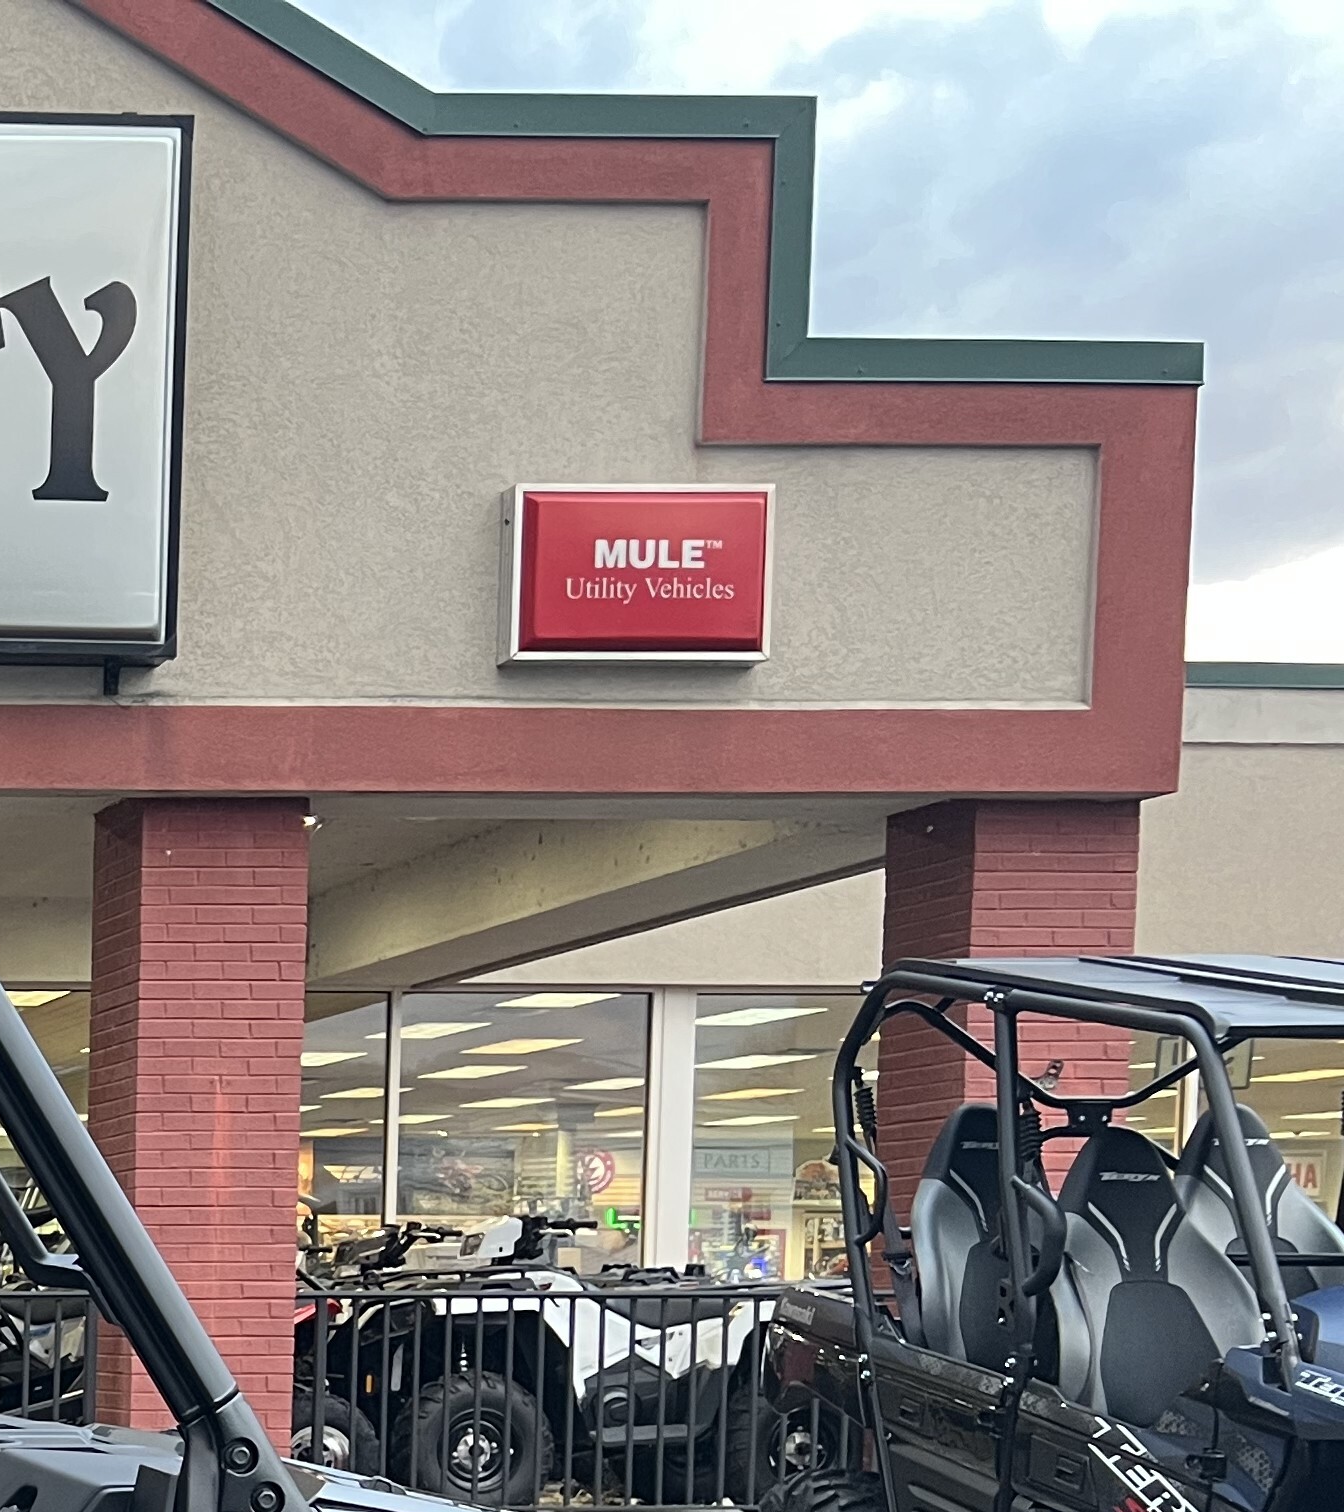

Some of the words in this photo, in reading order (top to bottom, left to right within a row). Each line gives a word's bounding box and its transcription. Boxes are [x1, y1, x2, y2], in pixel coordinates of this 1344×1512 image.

[566, 576, 637, 604] Utility
[645, 576, 735, 600] Vehicles
[703, 1152, 761, 1170] PARTS
